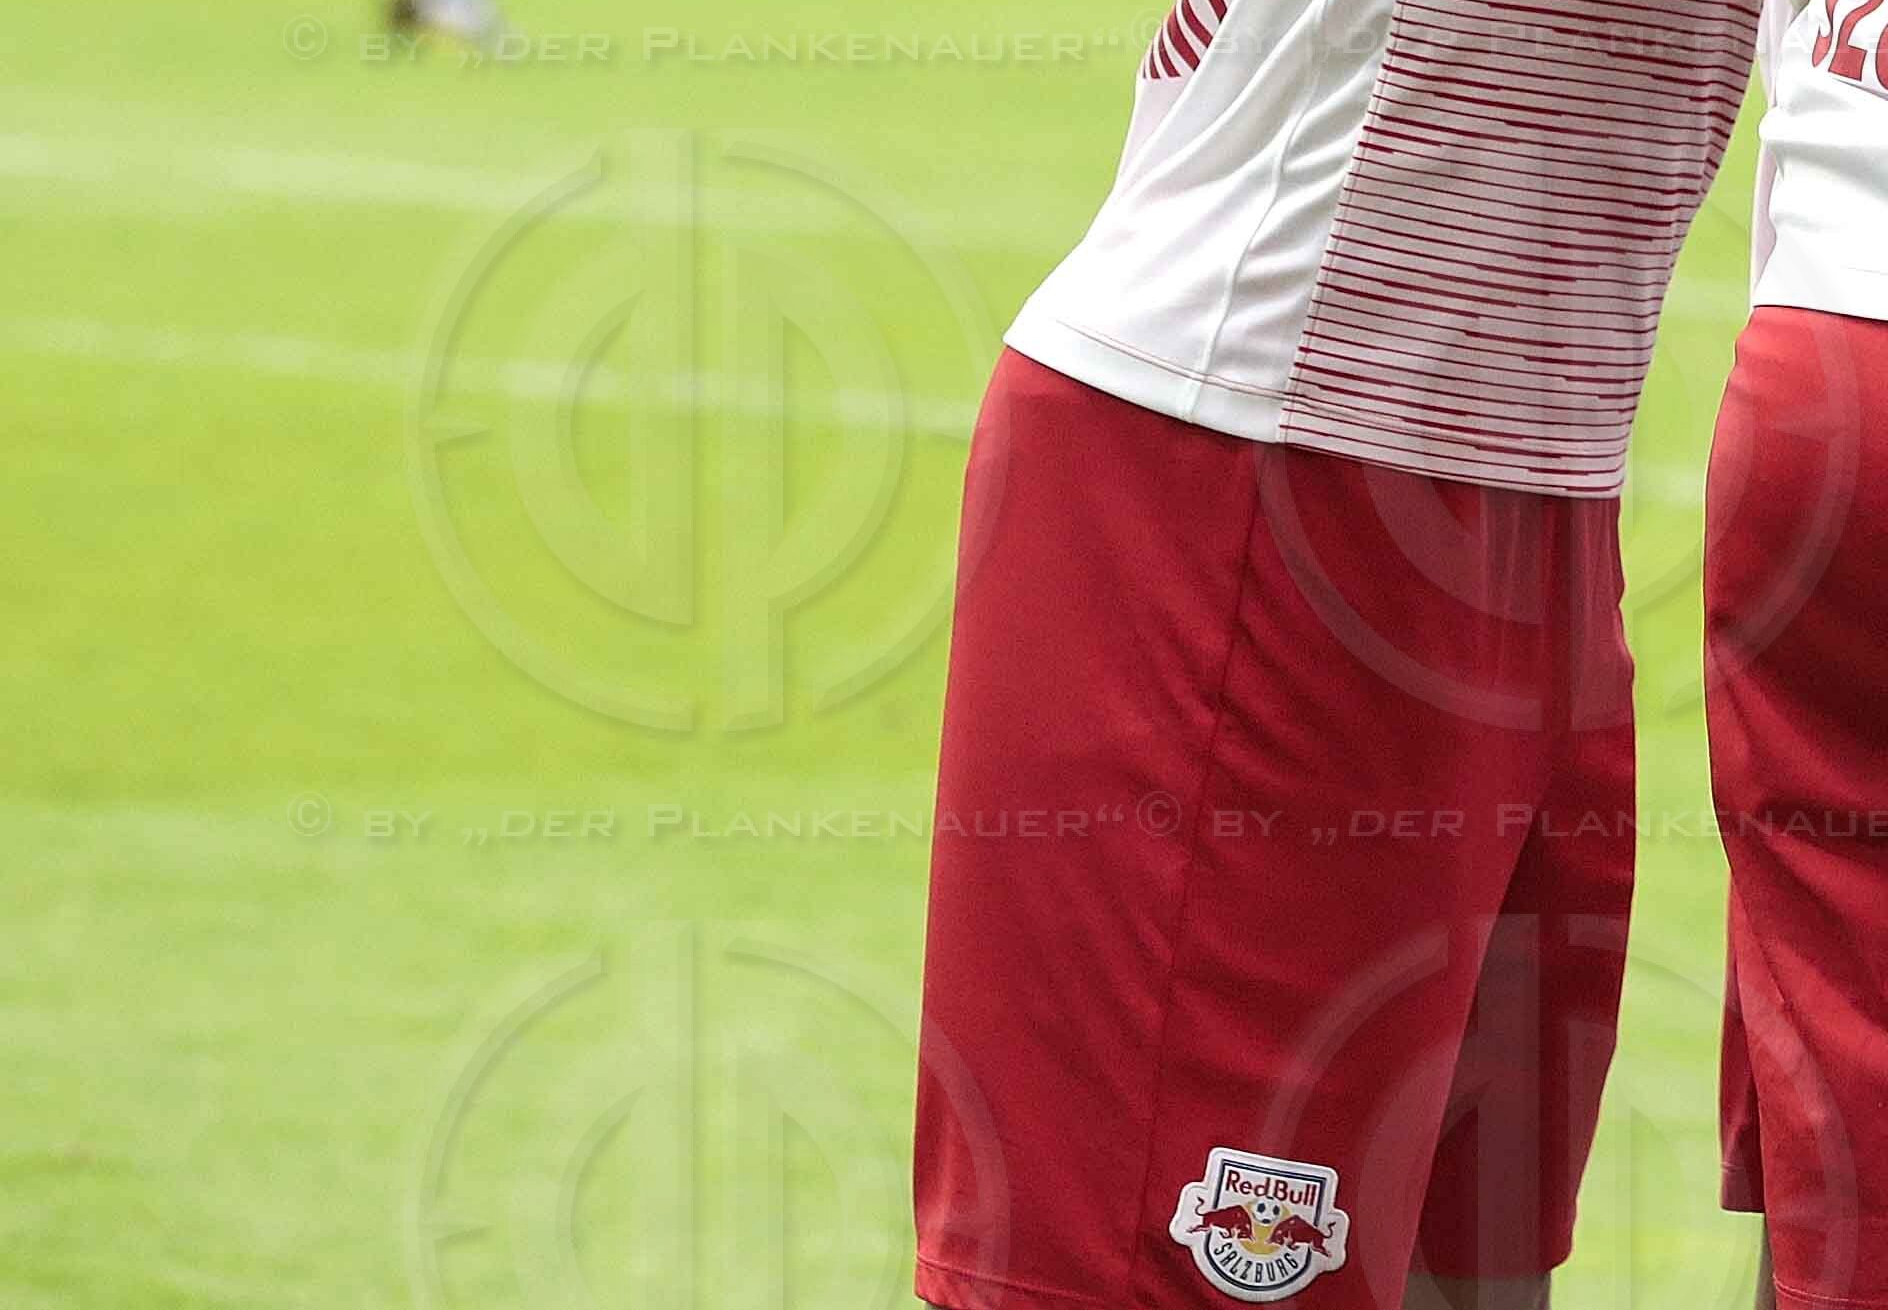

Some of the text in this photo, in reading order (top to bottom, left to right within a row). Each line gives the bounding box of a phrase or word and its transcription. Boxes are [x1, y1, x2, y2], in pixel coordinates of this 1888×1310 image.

[1225, 1169, 1319, 1207] Red Bull
[1213, 1241, 1299, 1283] SALZBURG
